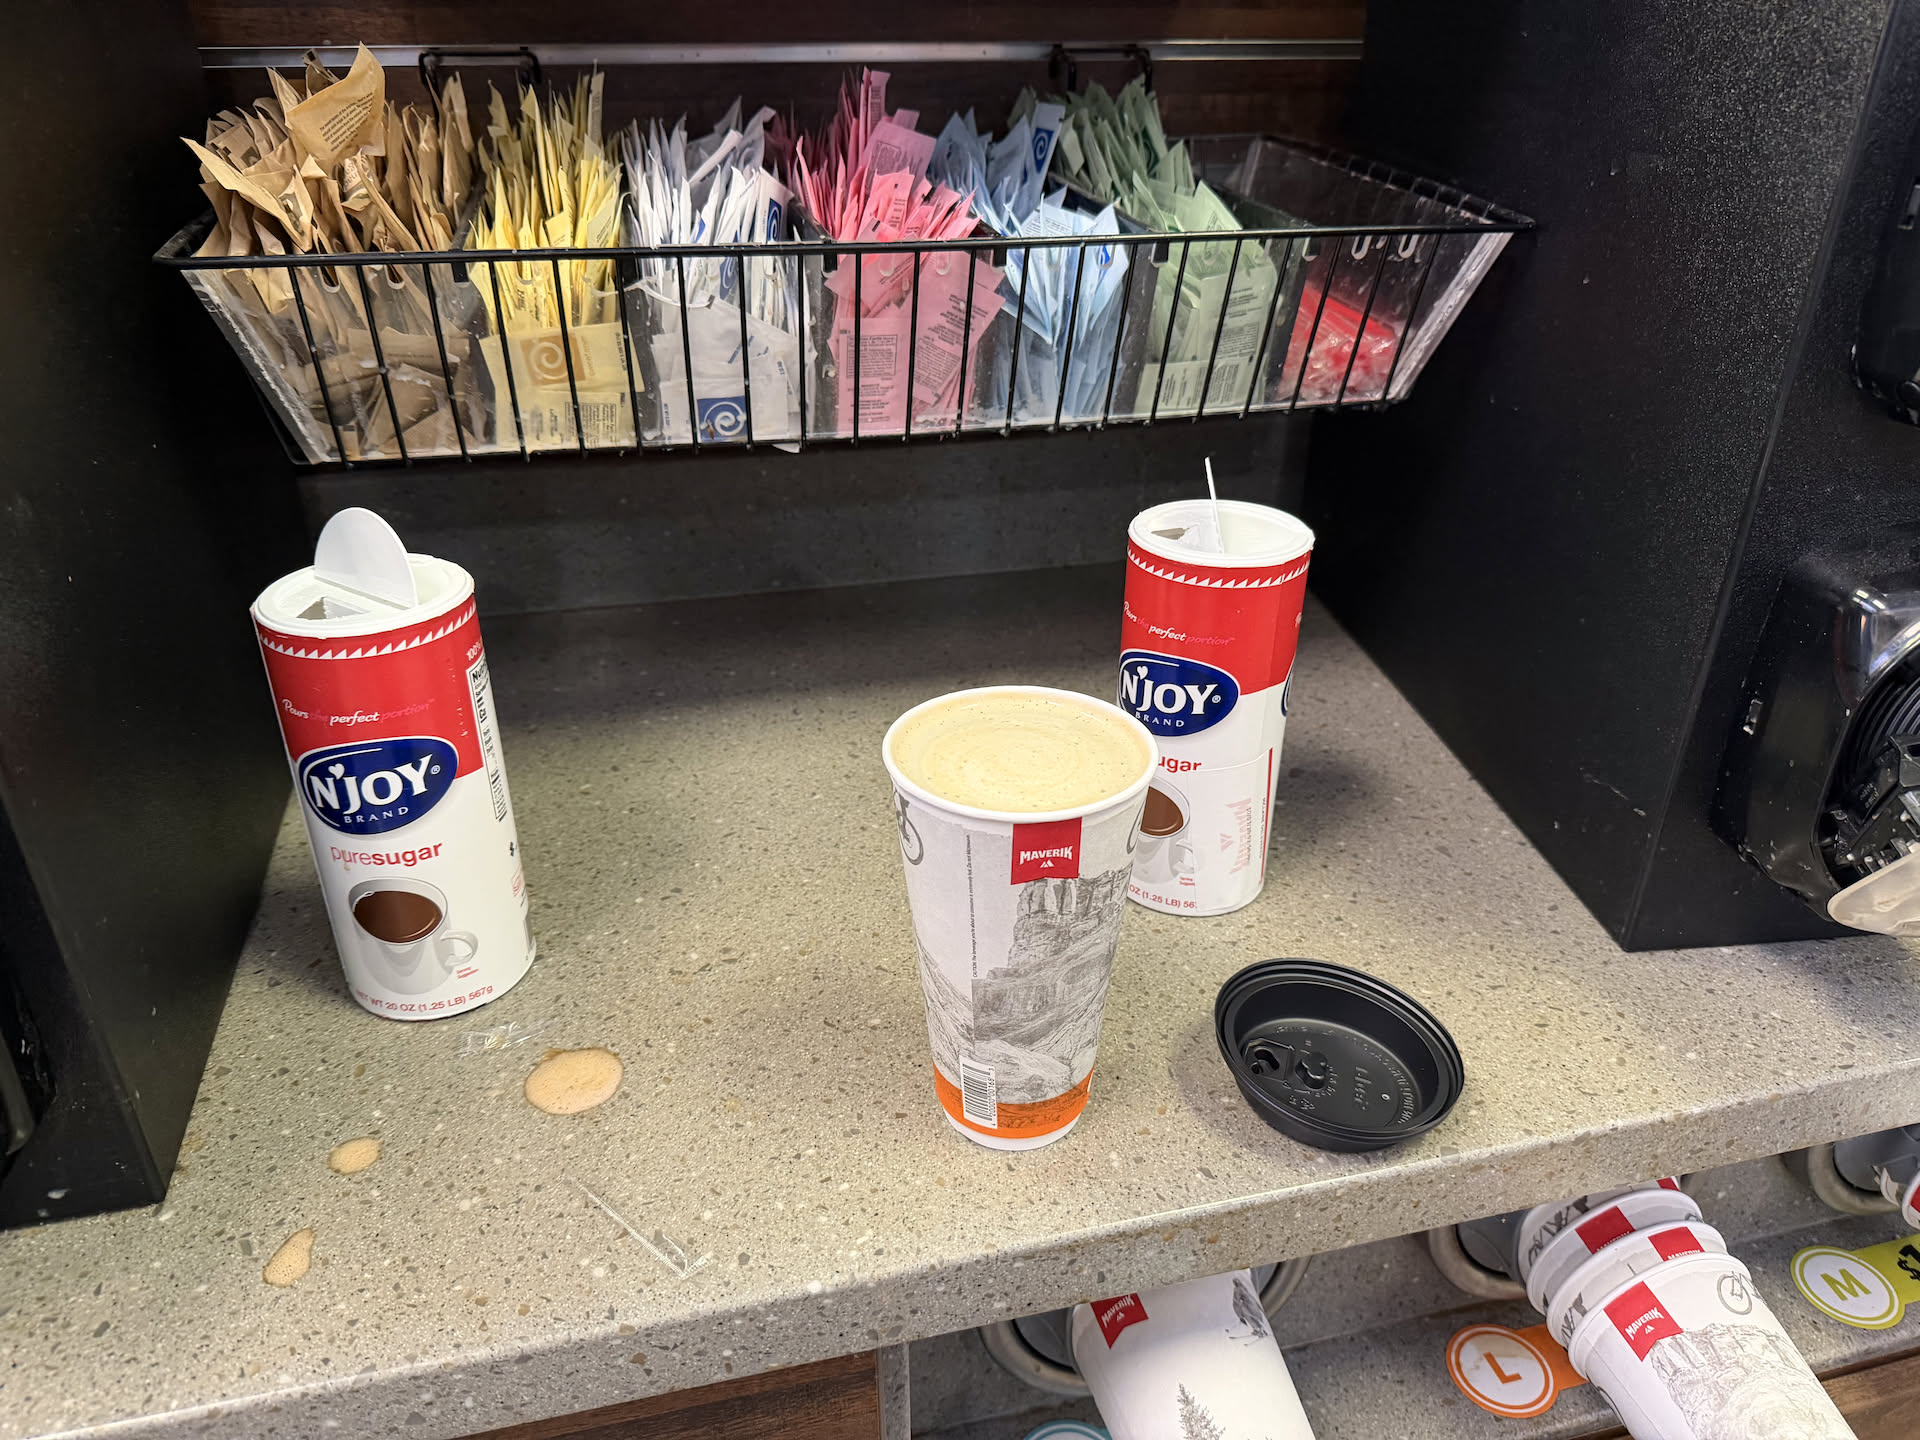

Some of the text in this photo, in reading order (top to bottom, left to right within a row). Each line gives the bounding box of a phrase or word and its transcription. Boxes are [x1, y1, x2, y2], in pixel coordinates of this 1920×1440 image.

[1124, 601, 1137, 622] Pours
[1148, 625, 1186, 641] perfect
[282, 698, 309, 719] Pours
[329, 710, 380, 726] perfect
[1135, 712, 1185, 727] BRAND
[343, 806, 409, 824] BRAND
[330, 842, 443, 867] puresugar
[1019, 845, 1073, 865] MAVERIK
[1129, 884, 1141, 895] OZ
[1142, 891, 1163, 903] (1.25
[1165, 898, 1181, 908] LB)
[370, 997, 383, 1007] WT
[386, 1002, 398, 1010] 20
[400, 1003, 415, 1012] OZ
[418, 1001, 445, 1012] (1.25
[448, 996, 466, 1007] LB)
[468, 985, 494, 1000] 567g
[1820, 1268, 1872, 1301] M
[1101, 1294, 1136, 1329] MAVERIK
[1624, 1307, 1664, 1340] MAVERIK
[1482, 1351, 1522, 1384] L
